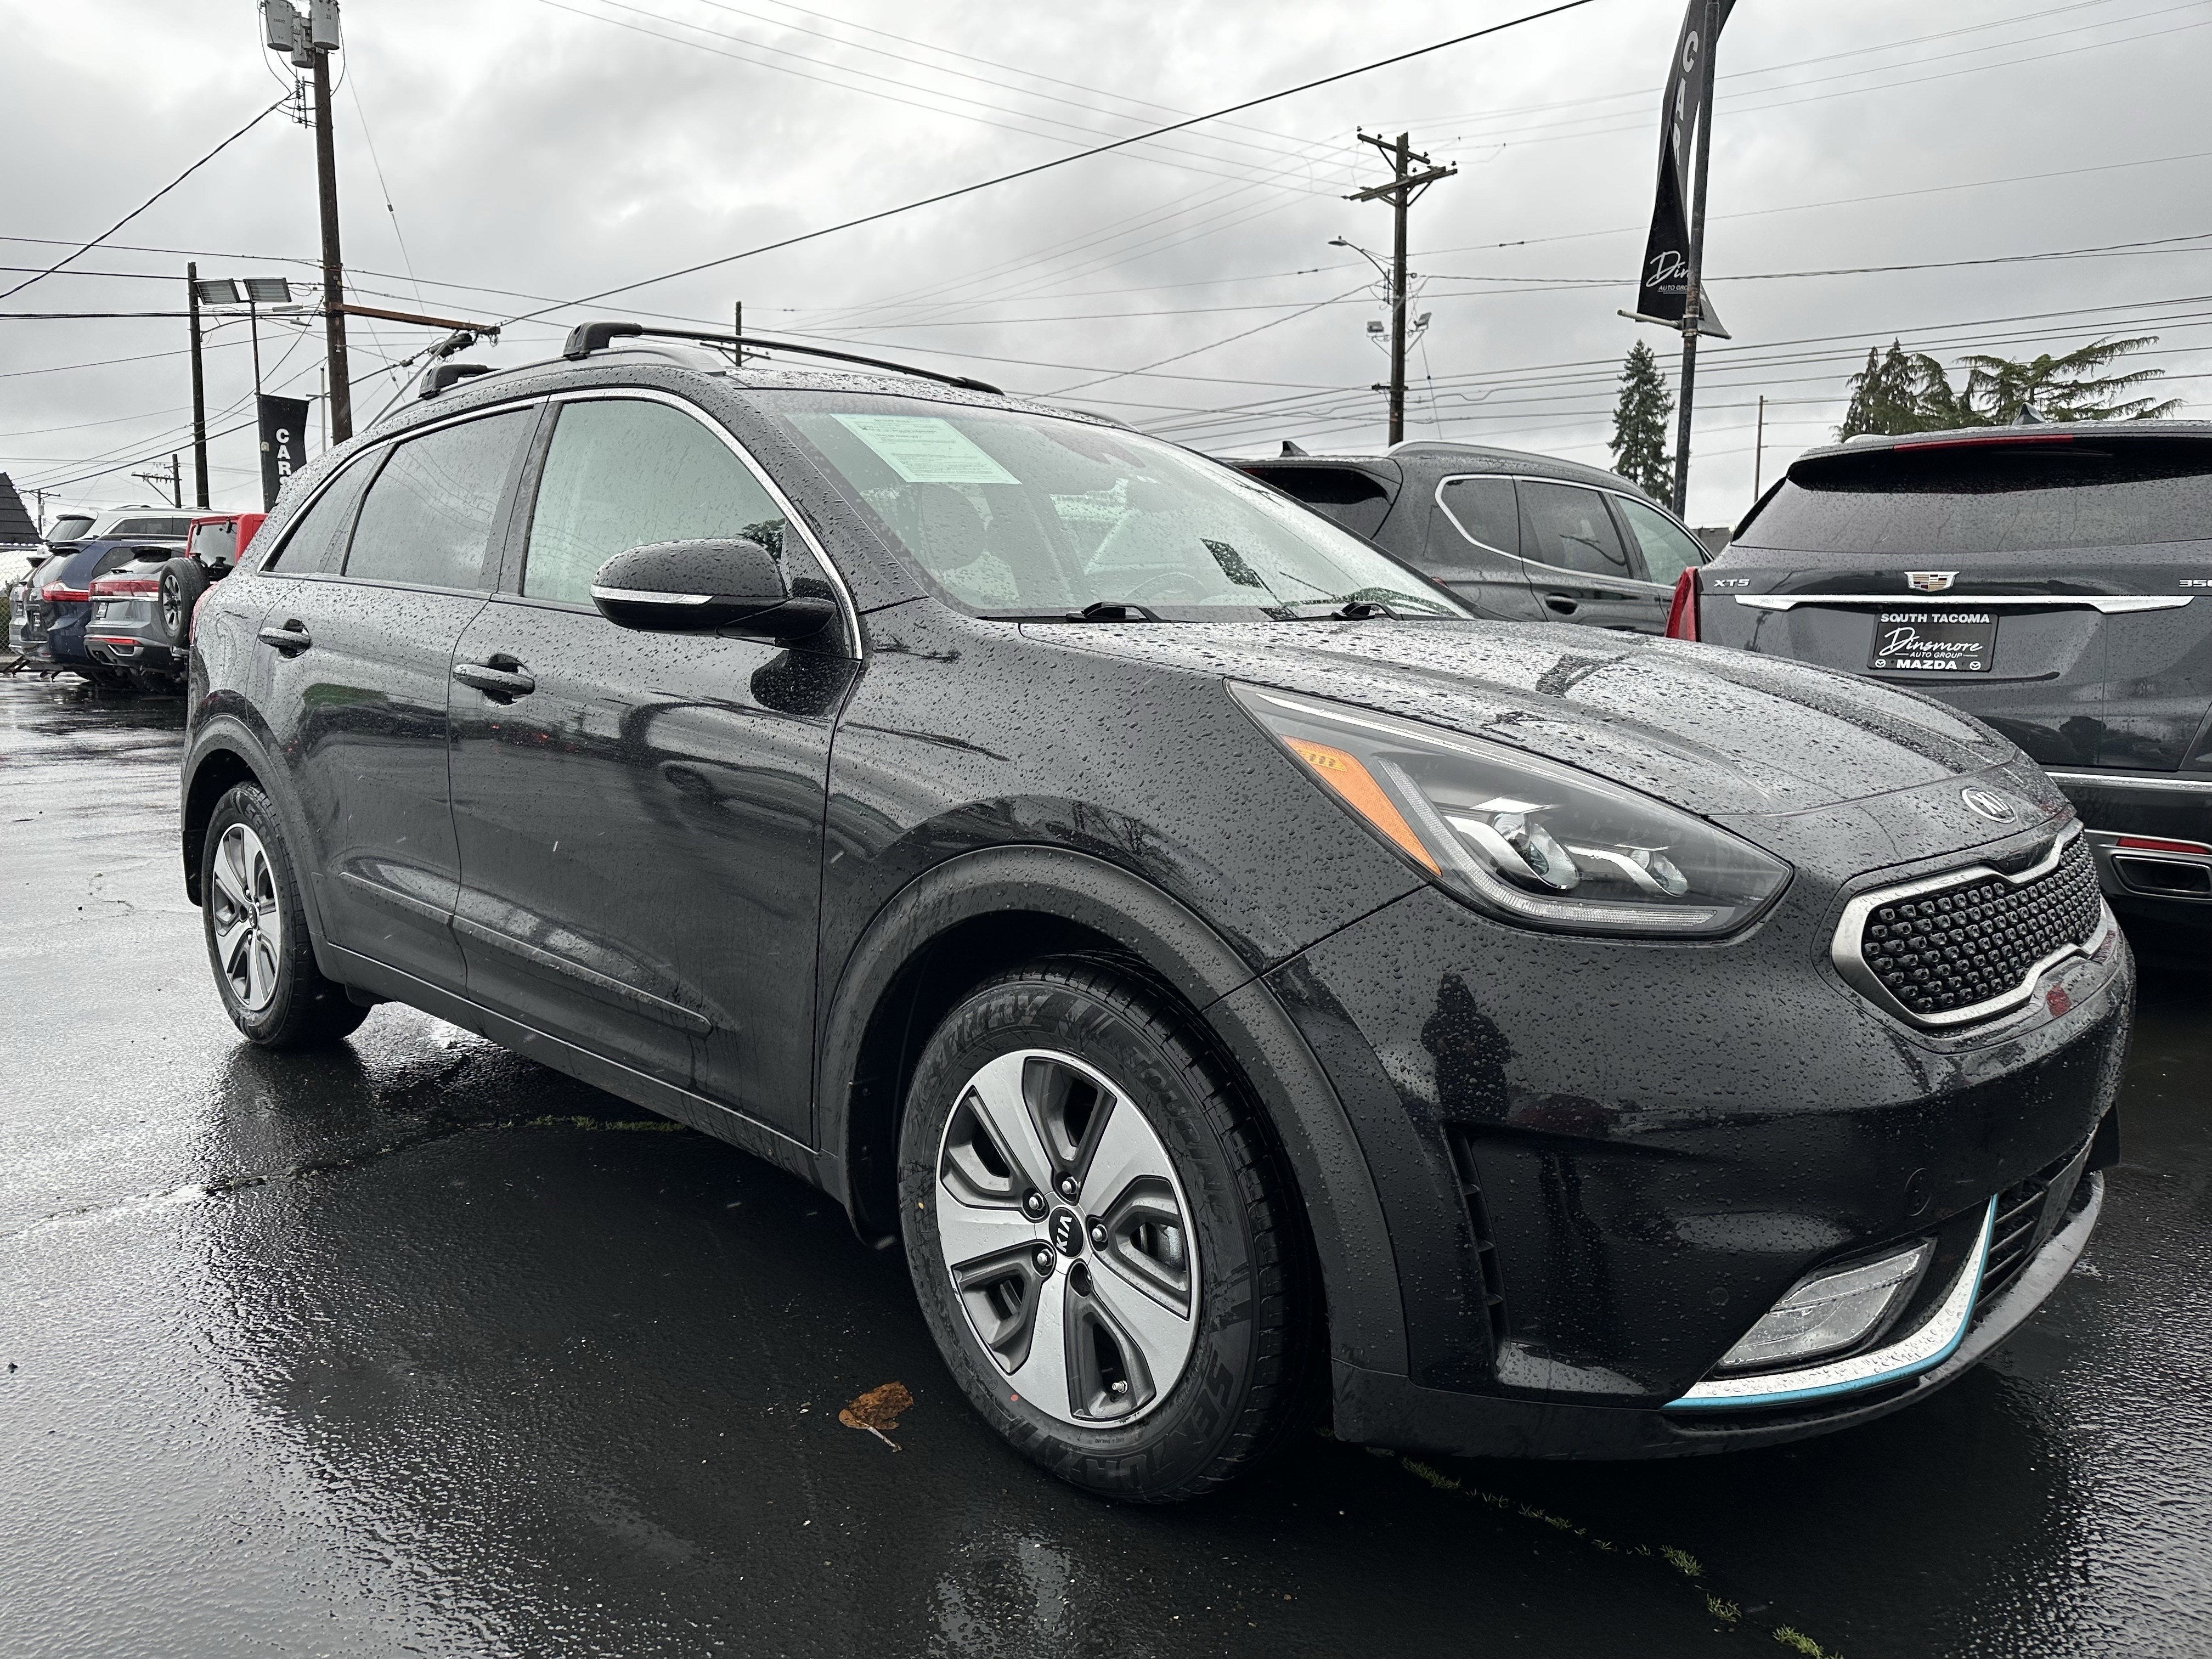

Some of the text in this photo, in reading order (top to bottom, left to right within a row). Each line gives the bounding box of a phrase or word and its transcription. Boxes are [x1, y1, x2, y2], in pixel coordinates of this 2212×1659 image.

[1713, 578, 1751, 587] XTS
[1881, 613, 1990, 623] SOUTH TACOMA
[1879, 627, 1983, 656] Dinsmore
[1896, 659, 1957, 670] MAZDA
[1056, 1216, 1073, 1253] KIA
